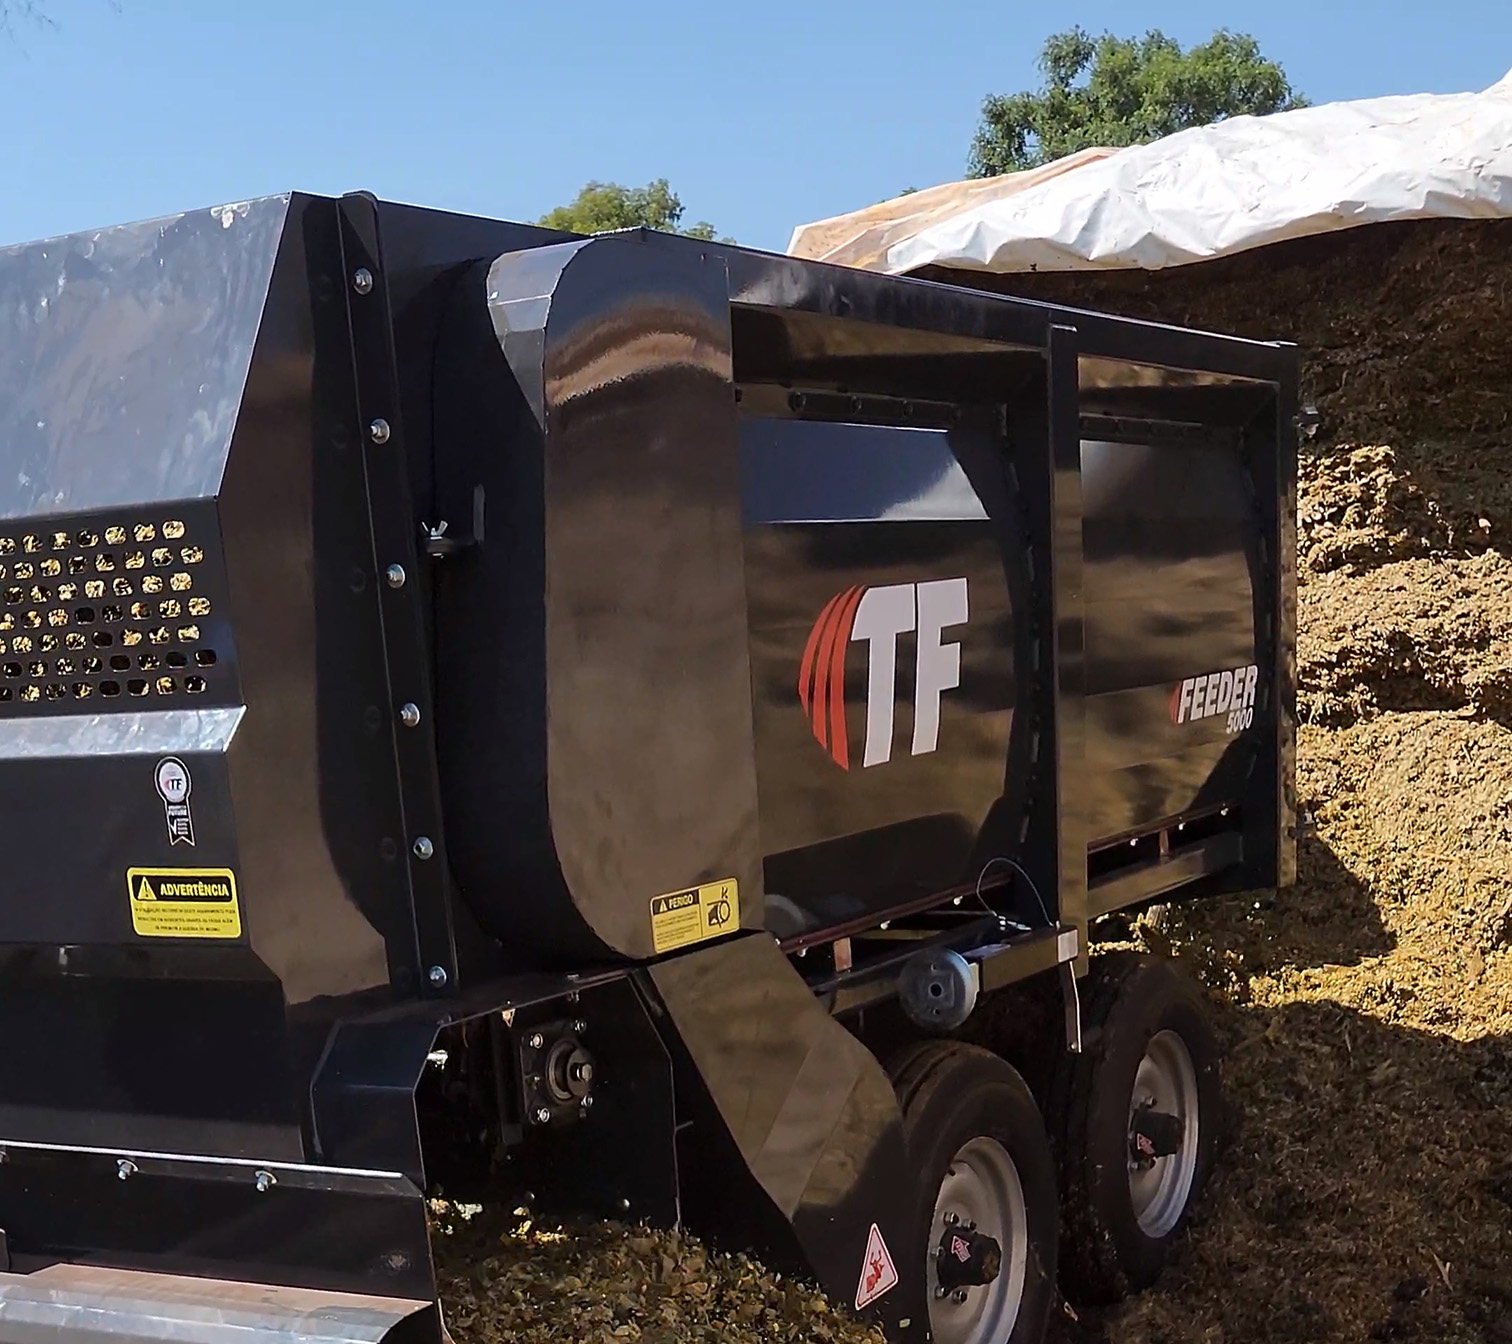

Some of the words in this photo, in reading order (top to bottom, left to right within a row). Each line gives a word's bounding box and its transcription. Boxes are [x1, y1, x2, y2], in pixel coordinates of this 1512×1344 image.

[851, 577, 968, 768] TF
[1178, 665, 1258, 724] FEEDER
[1226, 707, 1253, 734] 5000
[160, 881, 229, 896] ADVERTÊNCIA
[668, 894, 693, 909] PERIGO
